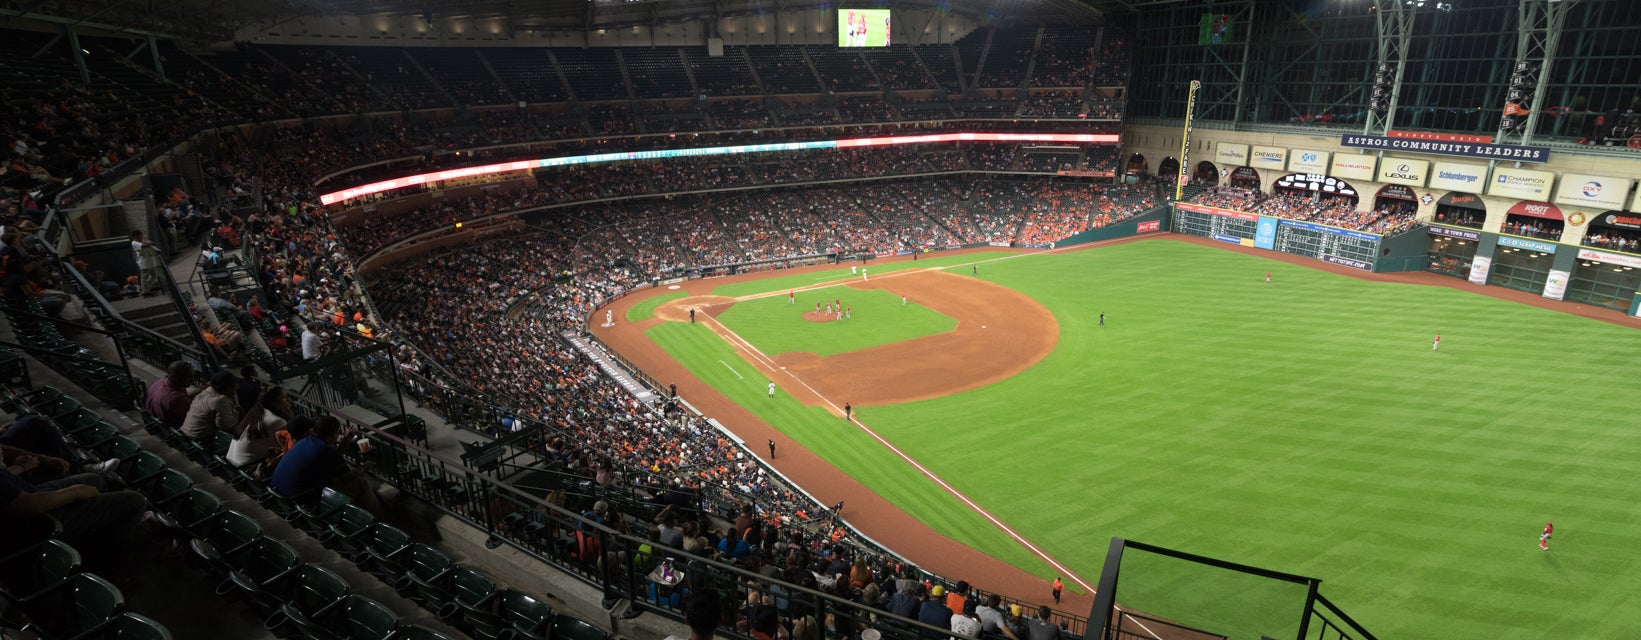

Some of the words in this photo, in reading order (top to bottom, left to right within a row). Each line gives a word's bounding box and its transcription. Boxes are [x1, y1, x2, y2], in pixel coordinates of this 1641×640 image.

[1348, 136, 1388, 147] ASTROS
[1393, 140, 1472, 153] COMMUNITY
[1476, 146, 1541, 158] LEADERS
[1385, 172, 1418, 180] LEXUS
[1439, 171, 1478, 182] Schlumberger
[1508, 176, 1545, 184] CHAMPION
[1524, 204, 1550, 212] ROOT
